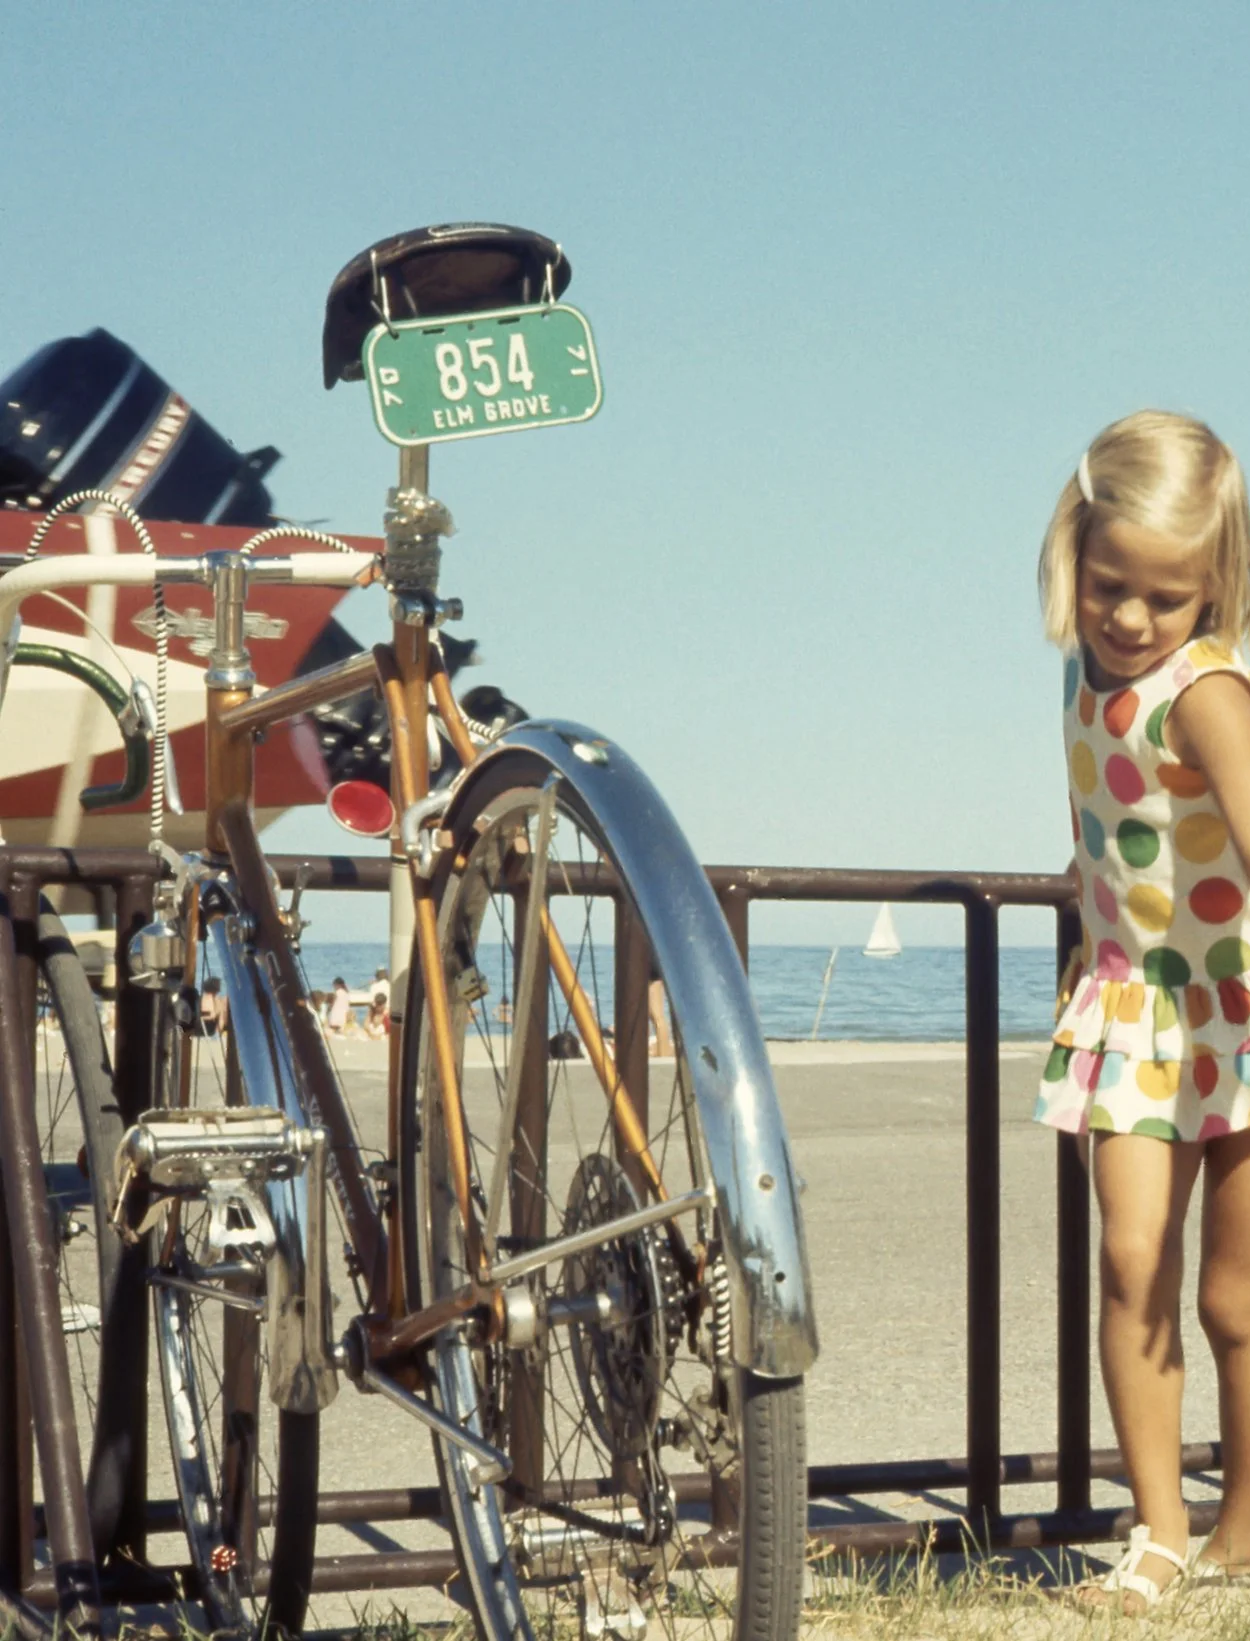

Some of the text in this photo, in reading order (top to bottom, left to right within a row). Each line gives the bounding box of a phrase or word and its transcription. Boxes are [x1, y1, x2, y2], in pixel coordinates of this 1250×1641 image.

[435, 333, 534, 401] 854
[433, 394, 552, 429] ELM GROVE
